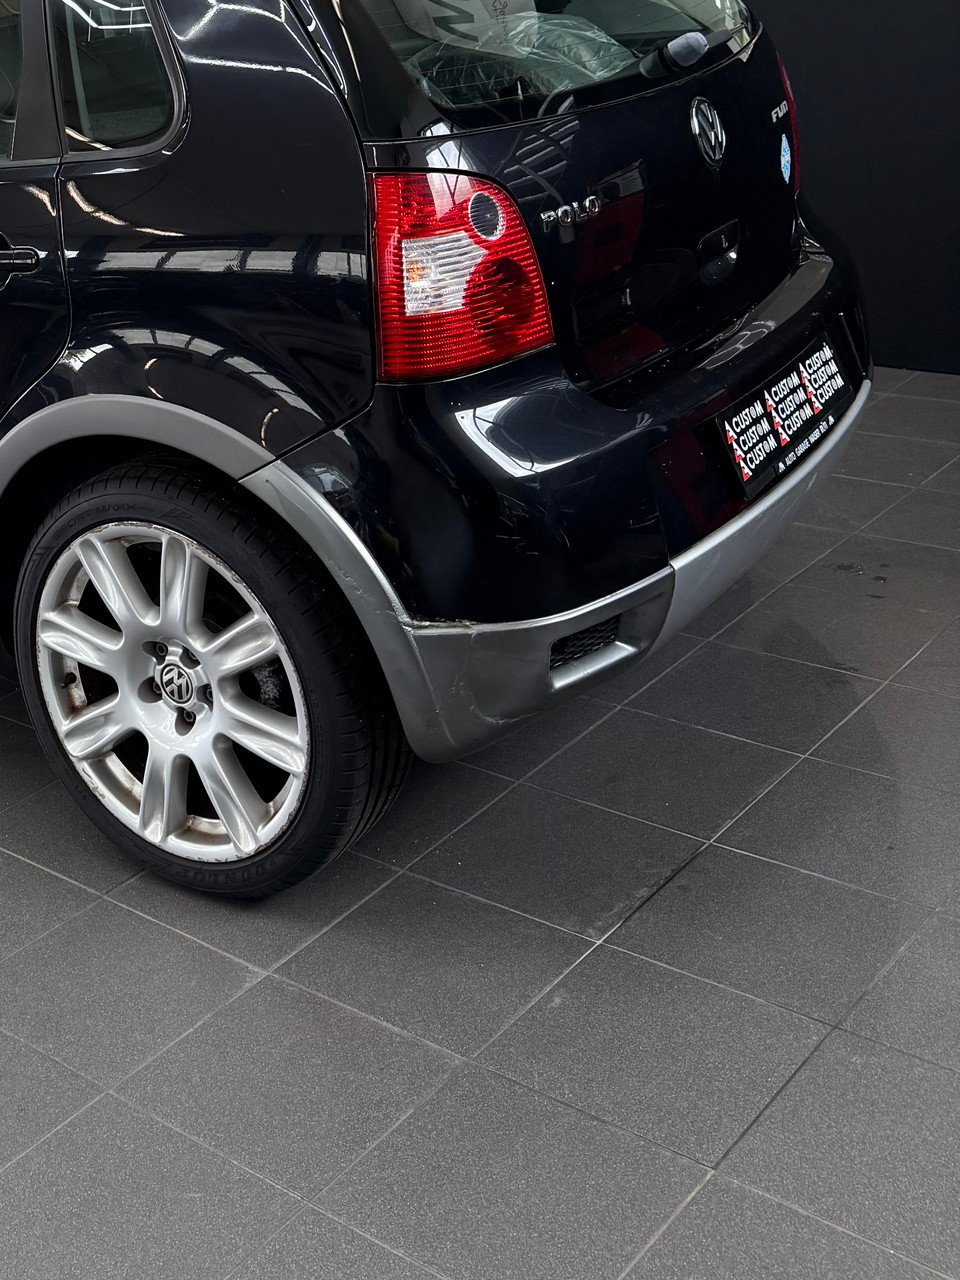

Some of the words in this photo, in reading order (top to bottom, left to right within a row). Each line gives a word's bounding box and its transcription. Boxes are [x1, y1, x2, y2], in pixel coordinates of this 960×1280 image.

[540, 195, 600, 232] POLO
[805, 345, 833, 374] CUSTOM
[810, 359, 839, 388] CUSTOM
[771, 371, 801, 401] CUSTOM
[817, 373, 844, 404] CUSTOM
[732, 400, 764, 433] CUSTOM
[778, 387, 807, 418] CUSTOM
[739, 417, 771, 451] CUSTOM
[784, 403, 814, 435] CUSTOM
[746, 434, 777, 469] CUSTOM
